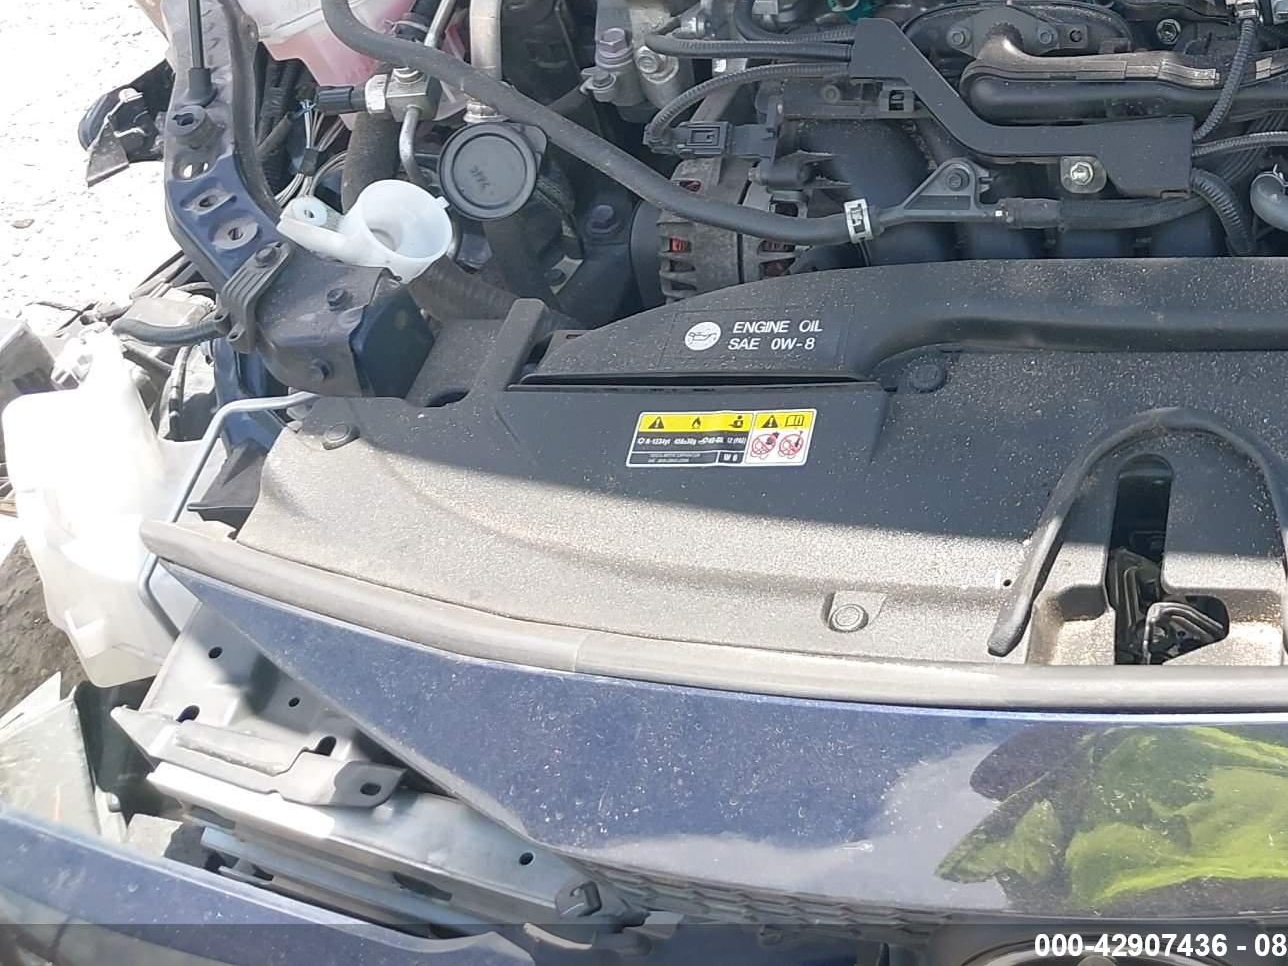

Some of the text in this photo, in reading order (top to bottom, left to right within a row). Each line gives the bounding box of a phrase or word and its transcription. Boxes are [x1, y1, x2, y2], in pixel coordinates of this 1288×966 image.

[732, 319, 823, 333] ENGINE OIL
[727, 337, 816, 350] SAE 0W-8
